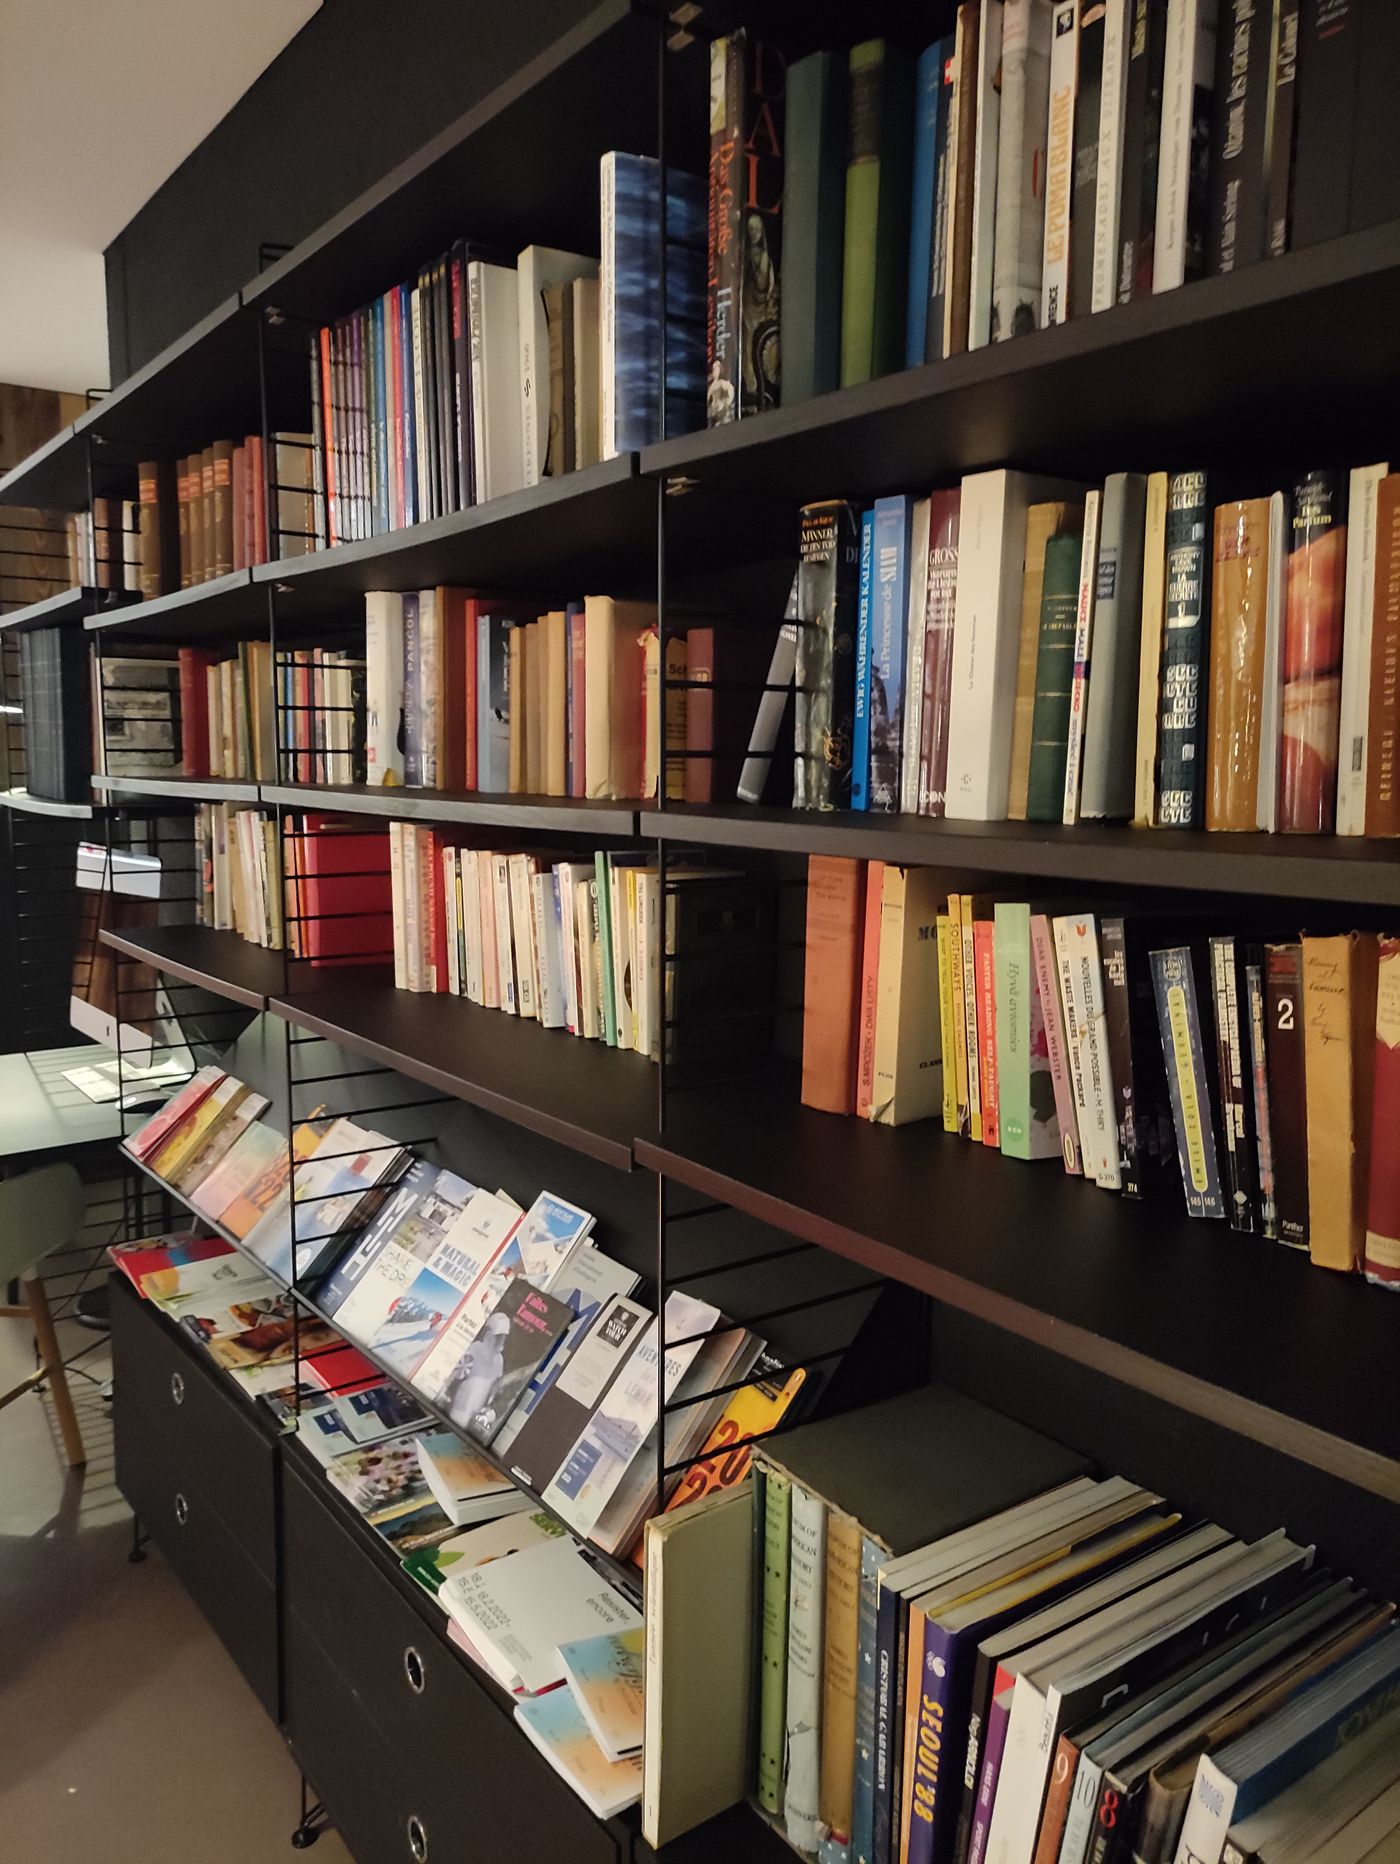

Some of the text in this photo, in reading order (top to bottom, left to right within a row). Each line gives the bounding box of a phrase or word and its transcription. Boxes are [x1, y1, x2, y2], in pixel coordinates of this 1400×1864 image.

[718, 140, 736, 168] Das
[1046, 85, 1072, 266] LE PUMA BLANC
[715, 286, 732, 360] Herder
[1292, 514, 1333, 529] Parfum
[884, 584, 893, 600] de
[856, 680, 866, 719] EWIG
[861, 523, 873, 597] KALENDER
[880, 600, 892, 663] Princesse
[405, 608, 415, 673] PANCOL
[879, 664, 890, 680] La
[950, 922, 962, 991] SOUTHWAYS
[964, 939, 972, 964] OTHER
[1035, 937, 1045, 963] DEAR
[1061, 959, 1070, 975] THE
[983, 952, 993, 990] FASTER
[1008, 961, 1020, 995] Hyvä
[1040, 964, 1050, 999] ENEMY
[1081, 955, 1092, 1000] NOUVELLES
[1063, 977, 1073, 1003] WASTE
[967, 1001, 975, 1027] OTHER
[984, 991, 993, 1037] READING
[1045, 1004, 1055, 1033] JEAN
[1066, 1005, 1078, 1039] MAKERS
[1086, 1001, 1094, 1017] DU
[1276, 997, 1295, 1031] 2
[968, 1029, 977, 1059] ROOMS
[1049, 1035, 1062, 1082] WEBSTER
[1090, 1051, 1102, 1093] POSSIBLE
[1075, 1073, 1087, 1109] Packard
[1281, 1219, 1305, 1232] Panther
[433, 1256, 471, 1288] & MAGIC
[440, 1242, 481, 1276] NATURAL
[460, 1312, 478, 1330] Partez
[585, 1597, 615, 1624] encore
[913, 1693, 944, 1824] SEOUL '88
[1053, 1752, 1069, 1785] 9
[1077, 1771, 1096, 1809] 10
[1100, 1788, 1119, 1828] 8
